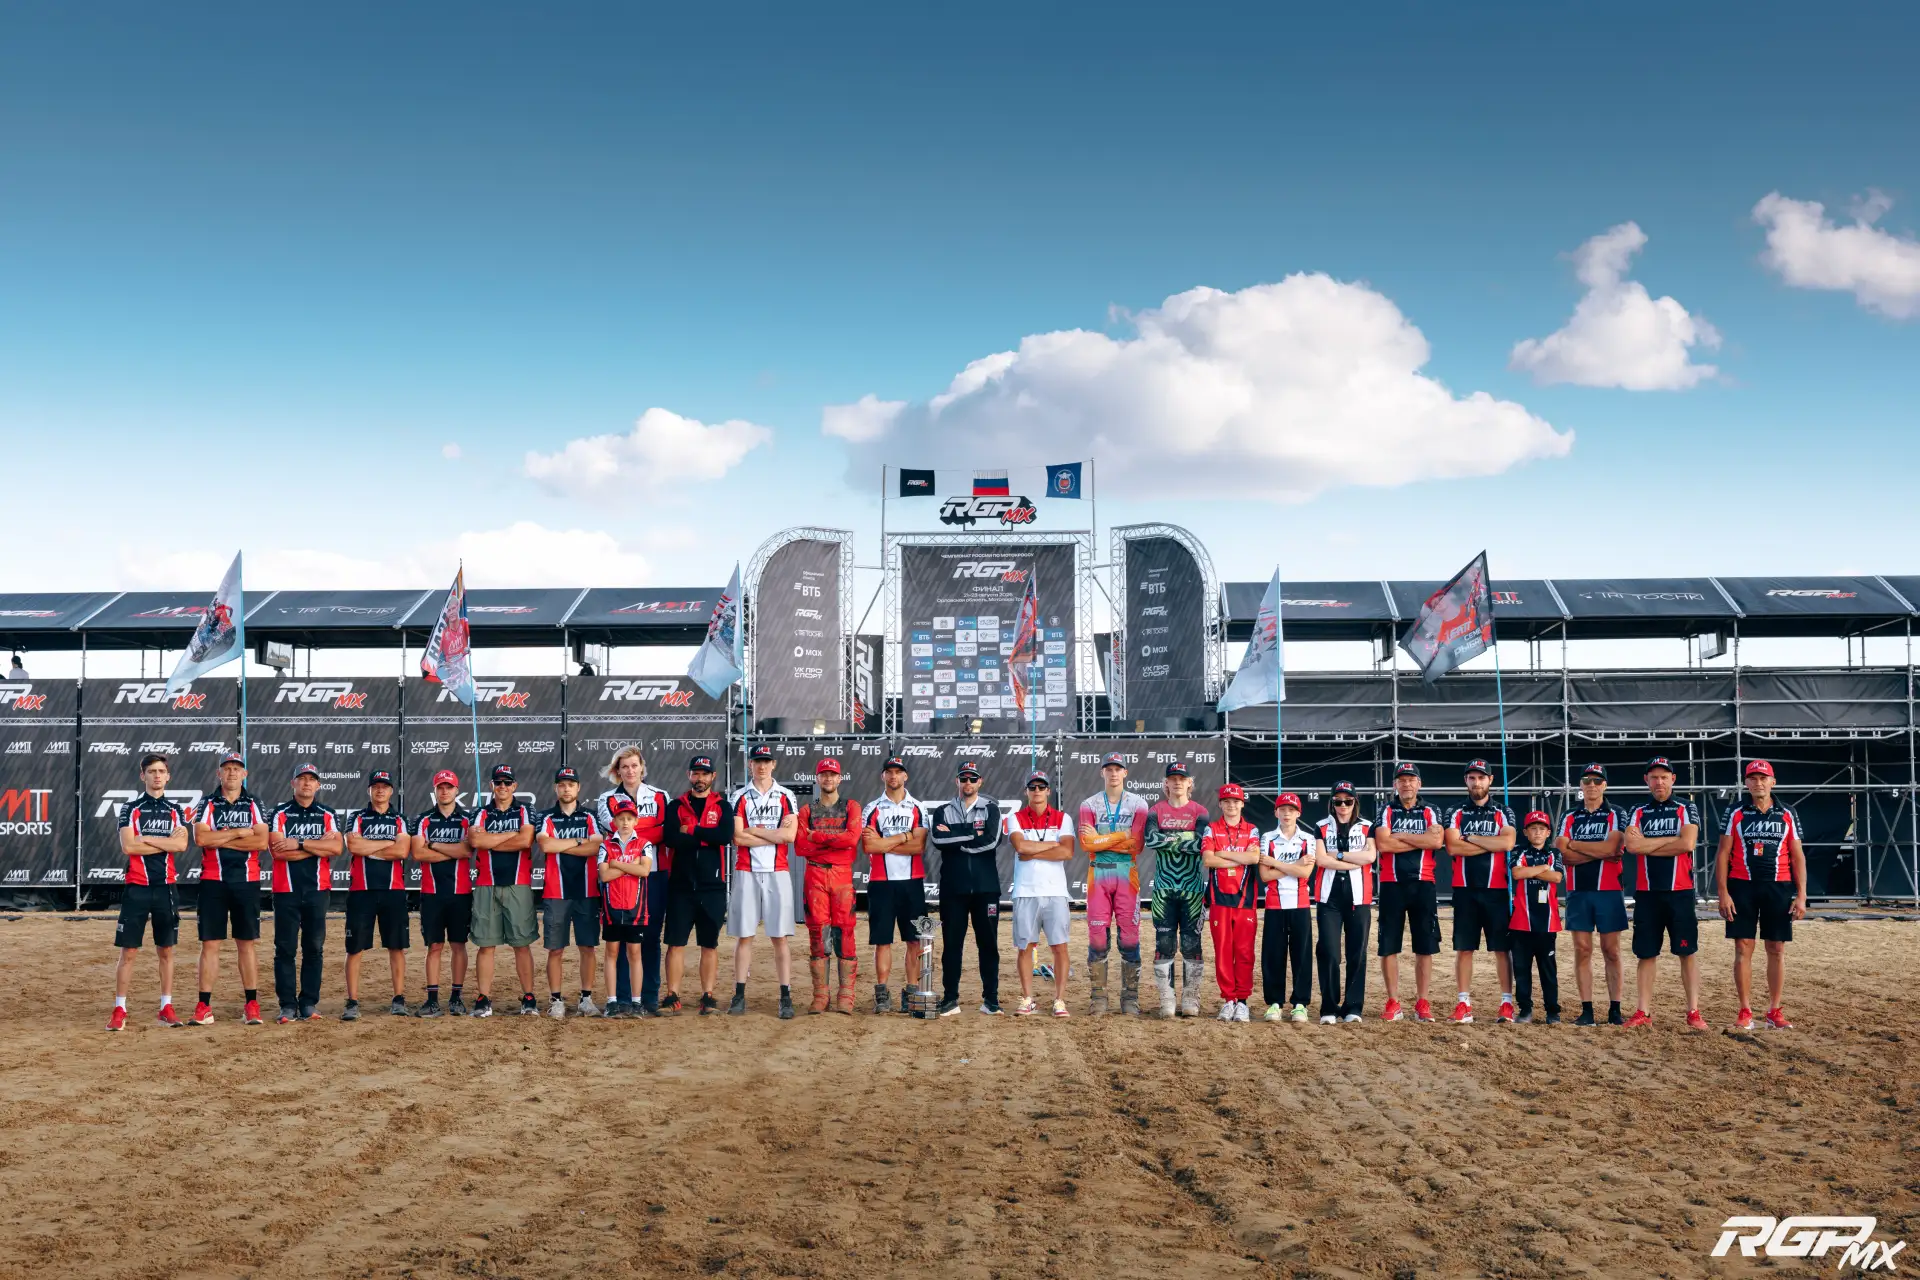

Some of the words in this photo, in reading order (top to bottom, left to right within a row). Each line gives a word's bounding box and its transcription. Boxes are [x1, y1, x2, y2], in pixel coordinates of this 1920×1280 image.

[942, 497, 1020, 517] RGP
[1002, 508, 1036, 523] MX
[953, 562, 1016, 578] RGP
[1001, 570, 1028, 583] MX
[803, 586, 820, 598] ВТБ
[1149, 582, 1166, 594] ВТБ
[1632, 592, 1704, 600] TOCHKI
[325, 606, 397, 614] TOCHKI
[795, 608, 818, 617] RGP
[1142, 606, 1164, 616] RGP
[114, 684, 192, 704] RGP
[172, 694, 206, 710] MX
[274, 682, 353, 702] RGP
[334, 693, 367, 709] MX
[599, 680, 679, 700] RGP
[660, 691, 694, 707] MX
[12, 694, 47, 710] MX
[496, 692, 530, 708] MX
[88, 742, 126, 752] RGP
[116, 747, 131, 755] MX
[139, 742, 175, 752] RGP
[166, 747, 181, 755] MX
[188, 742, 225, 751] RGP
[261, 744, 280, 754] ВТБ
[298, 744, 317, 754] ВТБ
[335, 744, 354, 754] ВТБ
[372, 744, 391, 754] ВТБ
[585, 739, 599, 750] TRI
[660, 739, 675, 750] TRI
[680, 740, 719, 750] TOCHKI
[1007, 745, 1044, 754] RGP
[786, 746, 805, 756] ВТБ
[824, 746, 843, 755] ВТБ
[862, 746, 881, 755] ВТБ
[901, 746, 937, 756] RGP
[954, 745, 990, 755] RGP
[1081, 754, 1100, 763] ВТБ
[1124, 754, 1138, 763] ТБ
[1157, 754, 1177, 763] ВТБ
[1195, 754, 1215, 762] ВТБ
[318, 771, 360, 779] ициальный
[794, 773, 851, 782] Офицый
[1127, 781, 1163, 789] Официал
[1578, 791, 1584, 799] 8
[1892, 789, 1899, 797] 5
[1161, 819, 1194, 828] LEATT
[1392, 819, 1424, 829] MMT
[1644, 818, 1676, 830] MMT
[1744, 821, 1782, 832] MMT
[87, 868, 123, 878] RGP
